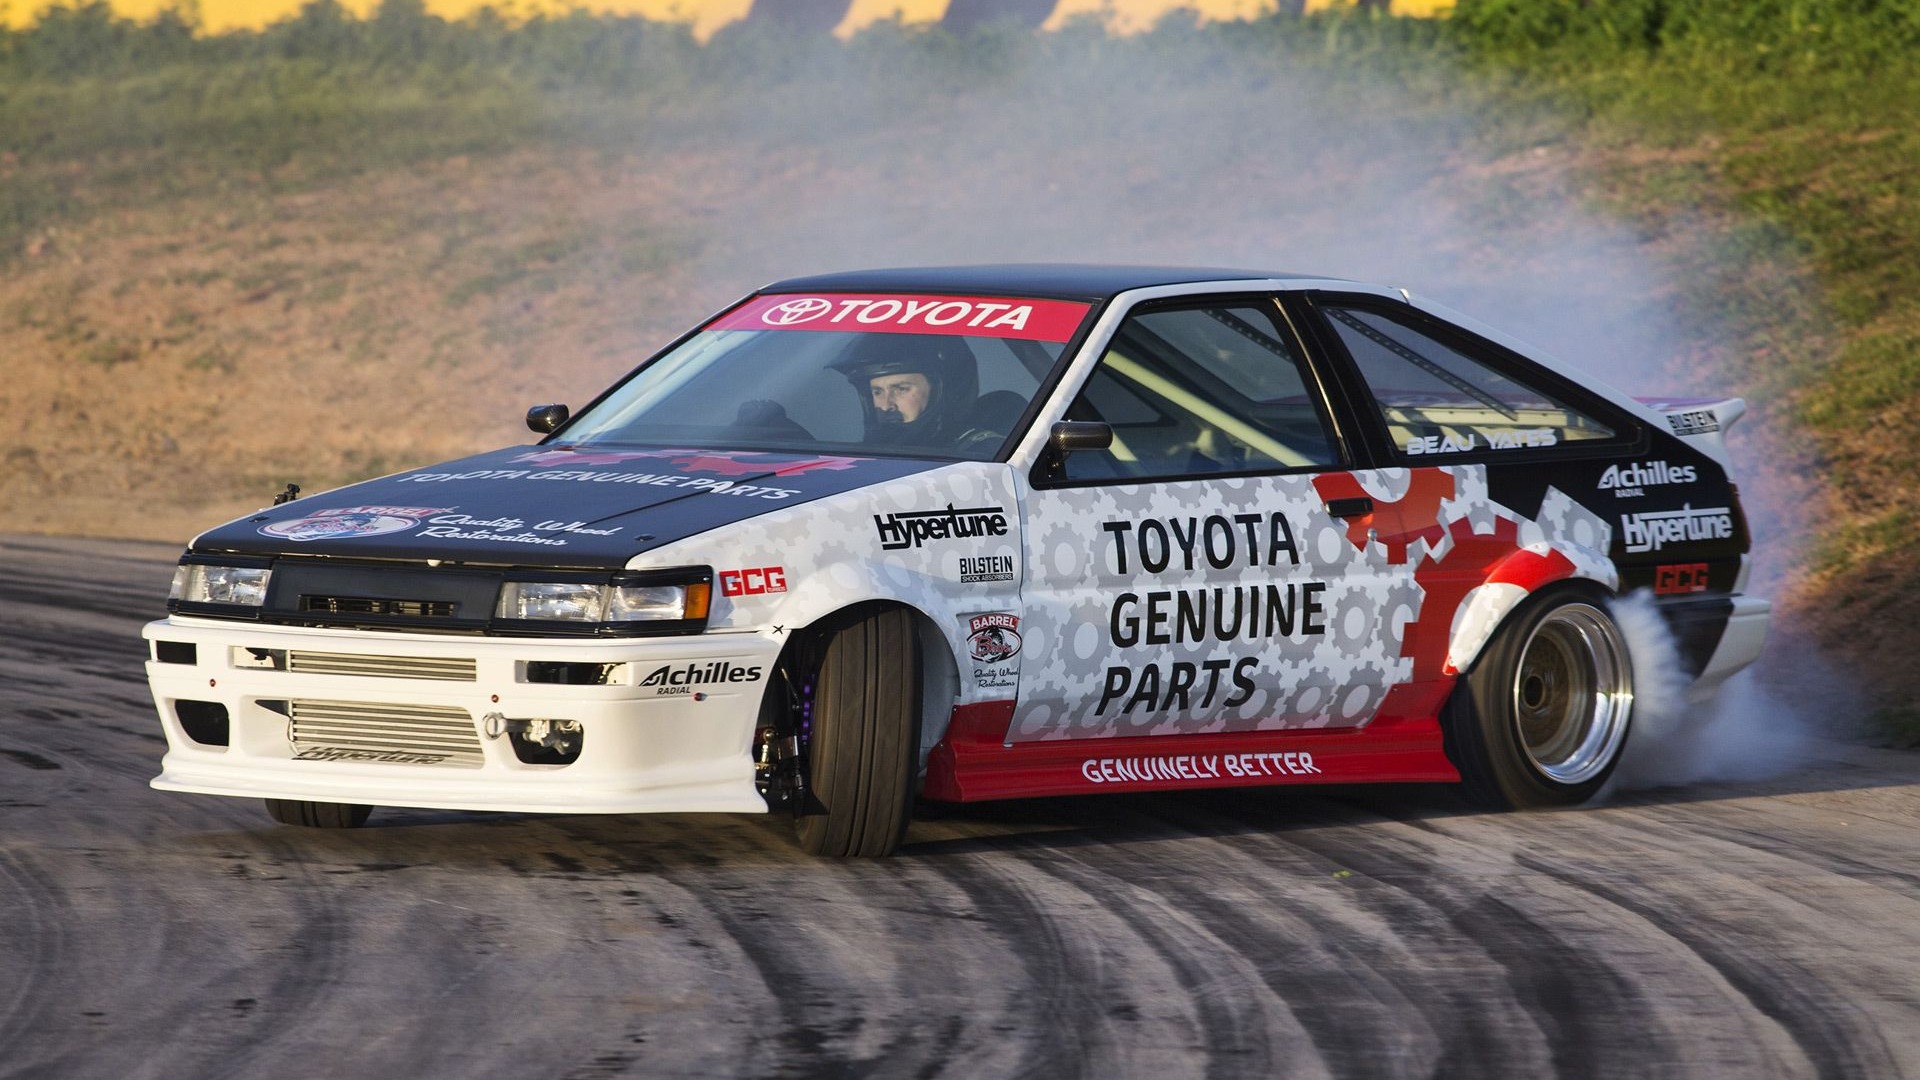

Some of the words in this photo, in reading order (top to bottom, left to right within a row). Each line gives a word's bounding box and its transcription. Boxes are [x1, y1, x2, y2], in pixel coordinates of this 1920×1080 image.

[830, 299, 1033, 331] TOYOTA
[1666, 409, 1719, 429] BILSTEIN
[1407, 434, 1475, 455] BEAU
[1484, 429, 1558, 450] YATES
[397, 470, 522, 482] TOYOTA
[530, 470, 679, 487] GENUINE
[676, 478, 802, 500] PARTS
[1597, 460, 1698, 489] Achilles
[1615, 487, 1645, 498] RADIAL
[415, 526, 568, 546] Restorations
[428, 514, 524, 531] Quality
[533, 520, 623, 537] Wheel
[873, 502, 1008, 551] Hypertune
[1621, 502, 1733, 553] Hypertune
[1103, 511, 1299, 574] TOYOTA
[959, 556, 1013, 575] BILSTEIN
[962, 575, 980, 583] SHOCK
[1655, 562, 1709, 595] GCG
[719, 566, 788, 597] GCG
[973, 616, 1016, 630] BARREL
[1110, 582, 1326, 648] GENUINE
[639, 661, 762, 687] Achilles
[974, 668, 997, 680] Quality
[1094, 656, 1260, 716] PARTS
[657, 686, 691, 695] RADIAL
[1081, 755, 1221, 783] GENUINELY
[1223, 752, 1322, 776] BETTER
